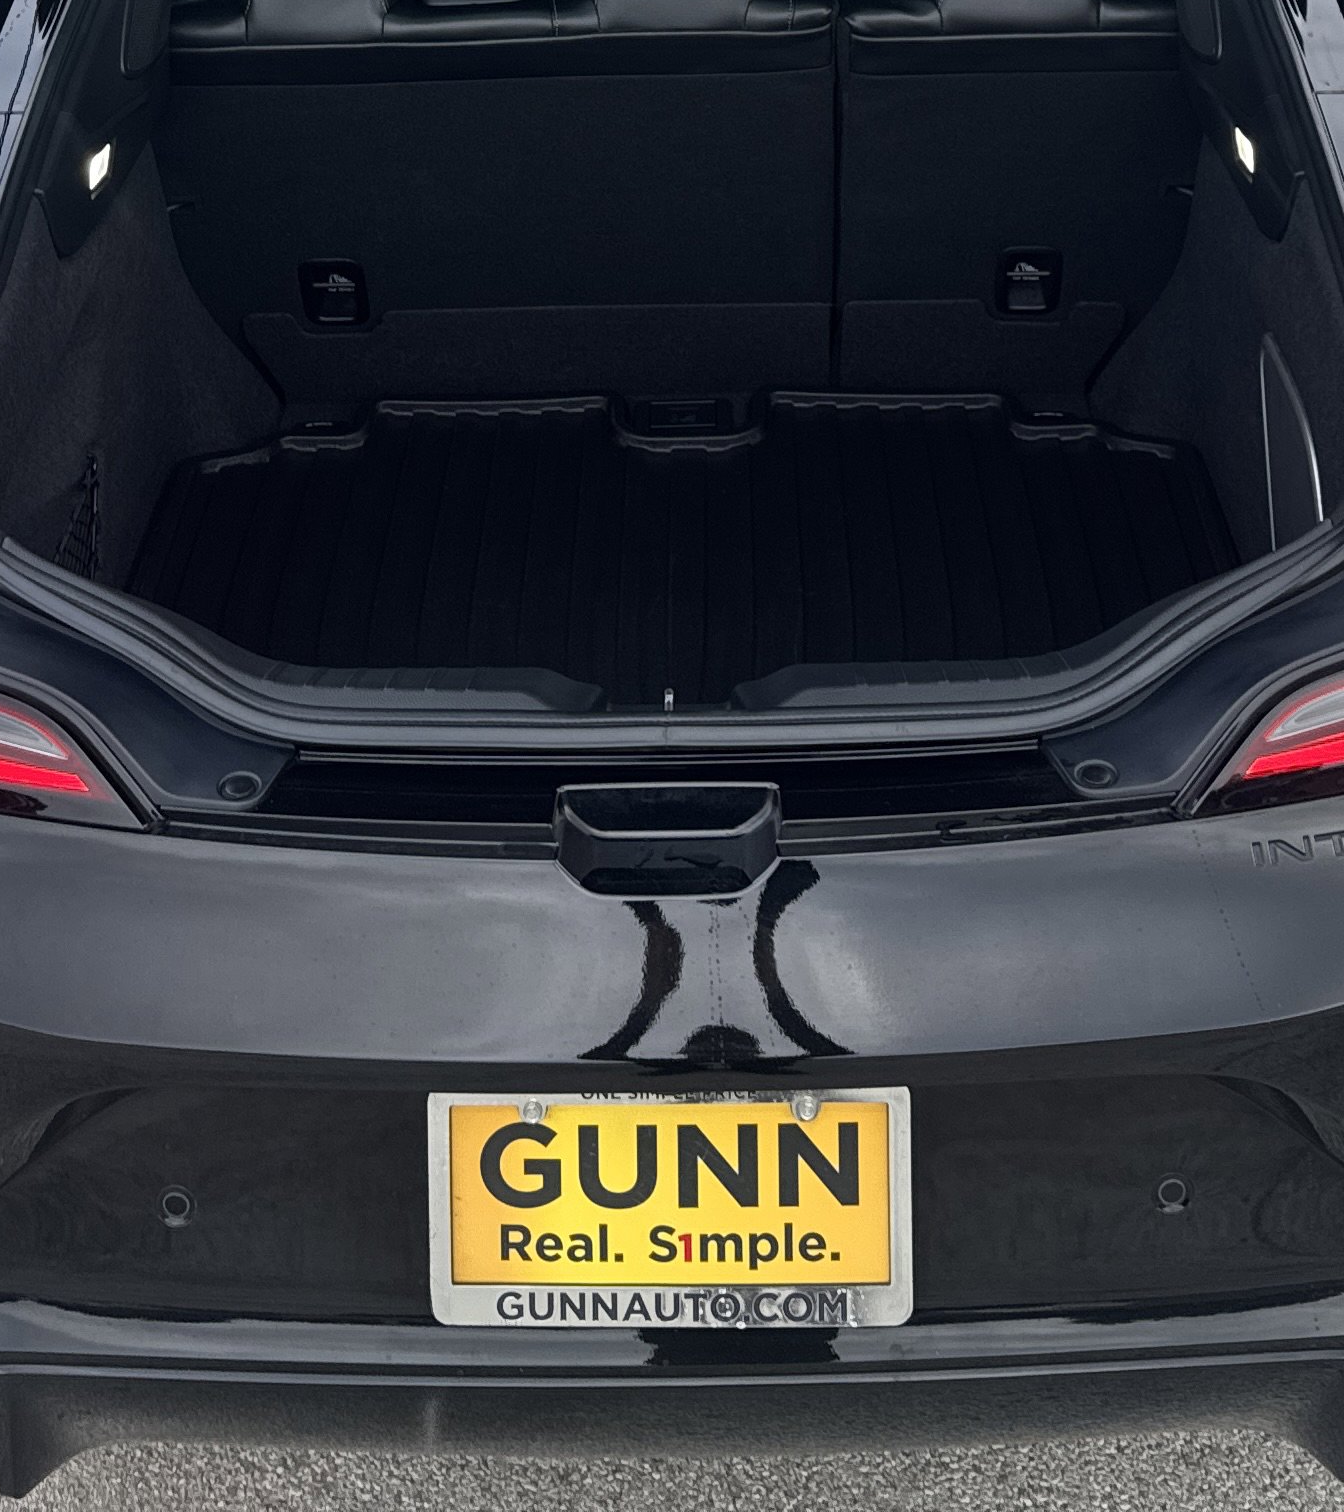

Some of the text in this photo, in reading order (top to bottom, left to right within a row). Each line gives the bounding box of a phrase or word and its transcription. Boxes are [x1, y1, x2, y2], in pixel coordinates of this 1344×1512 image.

[480, 1121, 860, 1209] GUNN
[500, 1223, 624, 1263] Real.
[496, 1291, 848, 1323] GUNNAUTO.COM
